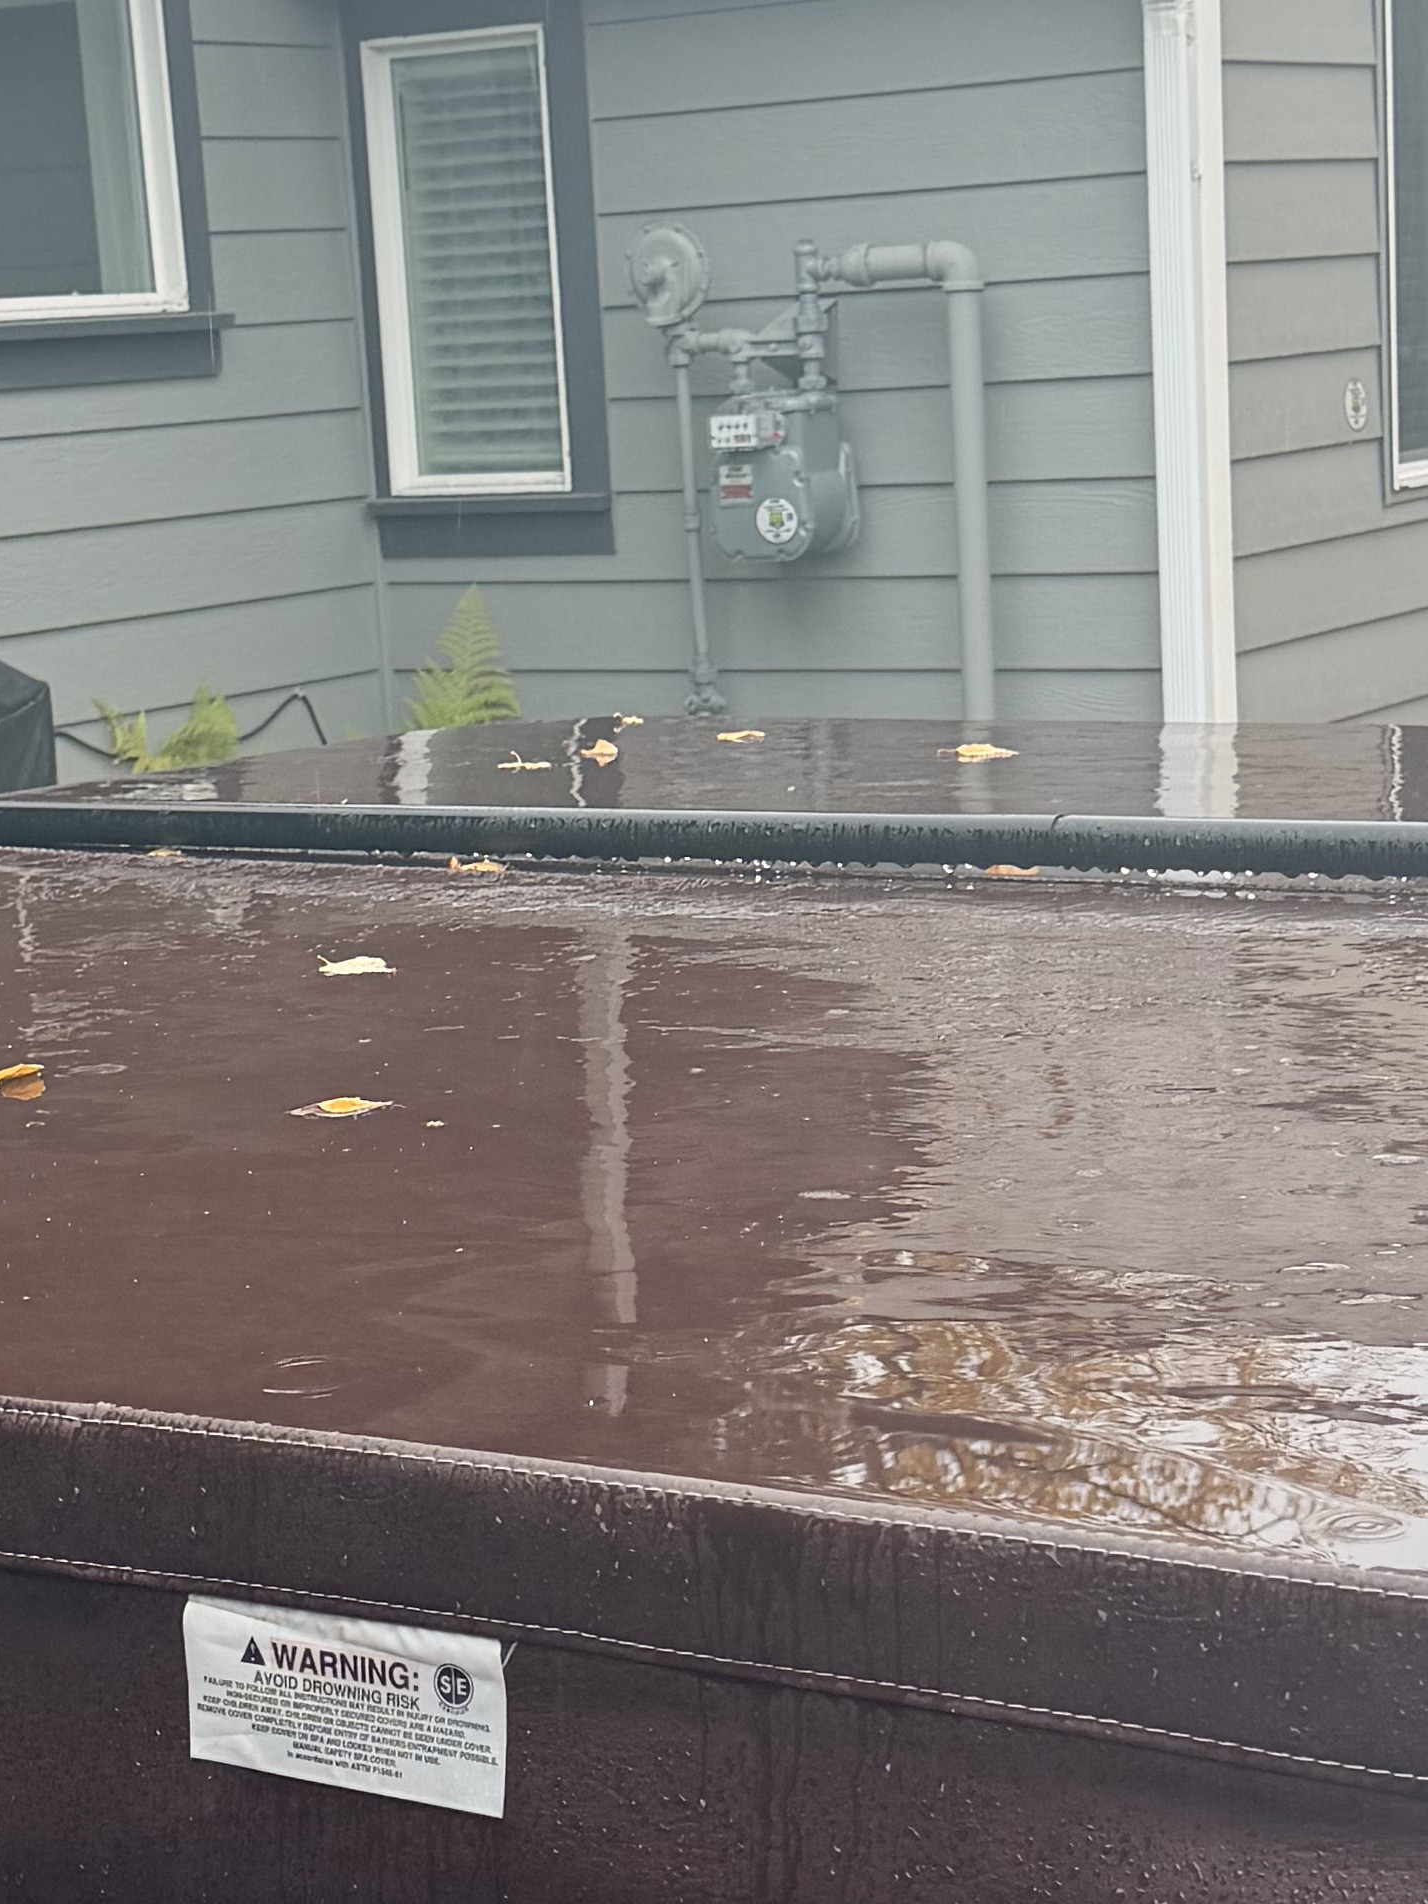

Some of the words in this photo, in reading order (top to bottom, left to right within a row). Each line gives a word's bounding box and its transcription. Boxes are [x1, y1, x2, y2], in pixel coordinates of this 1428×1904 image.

[272, 1642, 419, 1692] WARNING:
[254, 1670, 298, 1690] AVOID
[303, 1678, 382, 1705] DROWNING
[386, 1692, 421, 1711] RISK
